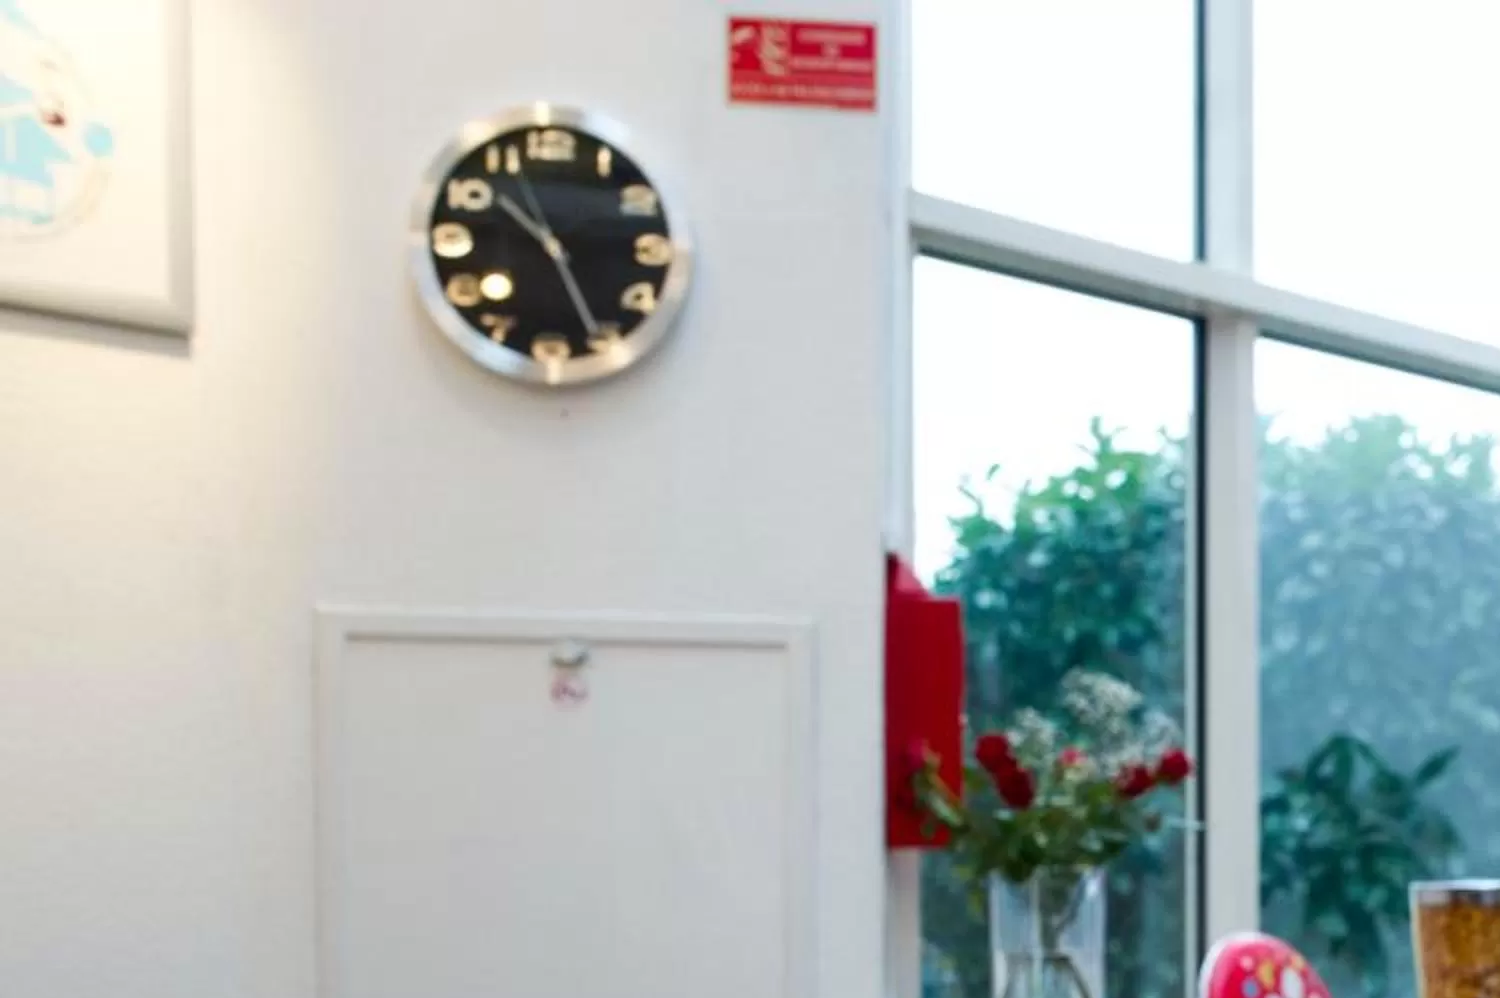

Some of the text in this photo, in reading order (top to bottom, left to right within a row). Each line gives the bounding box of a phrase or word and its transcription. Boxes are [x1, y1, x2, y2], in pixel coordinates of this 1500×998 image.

[485, 144, 521, 174] 11
[597, 146, 612, 177] 1
[447, 178, 493, 211] 10
[620, 282, 655, 312] 4
